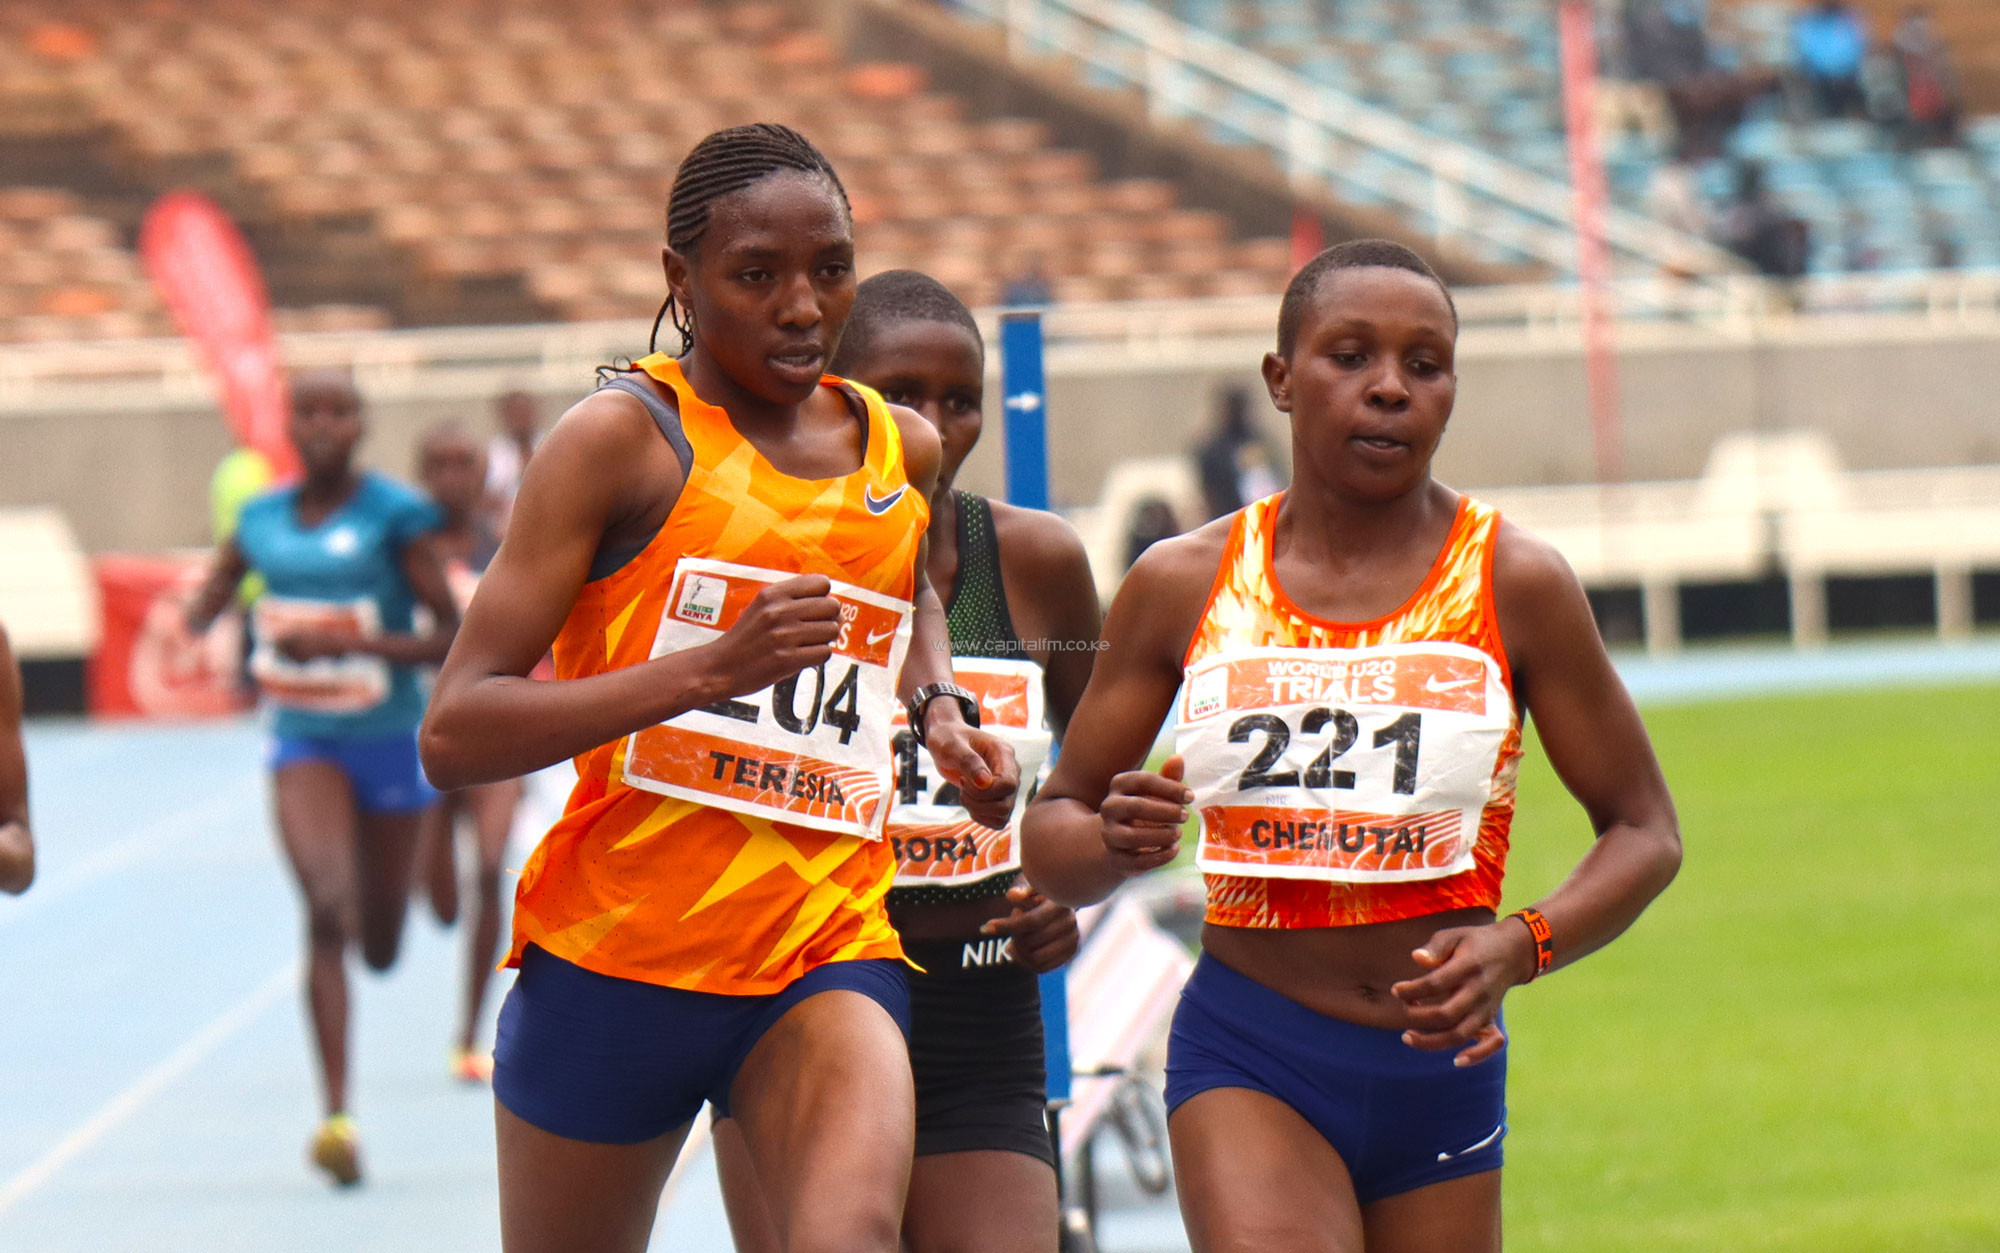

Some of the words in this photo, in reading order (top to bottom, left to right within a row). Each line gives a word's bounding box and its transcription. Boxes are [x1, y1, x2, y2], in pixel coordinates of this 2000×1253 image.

[681, 609, 713, 622] KENYA
[1265, 675, 1397, 704] TRIALS
[1267, 660, 1347, 679] WORLD
[1351, 660, 1396, 677] U20
[692, 663, 861, 746] 04
[1227, 707, 1422, 796] 221
[709, 750, 846, 807] TERESIA
